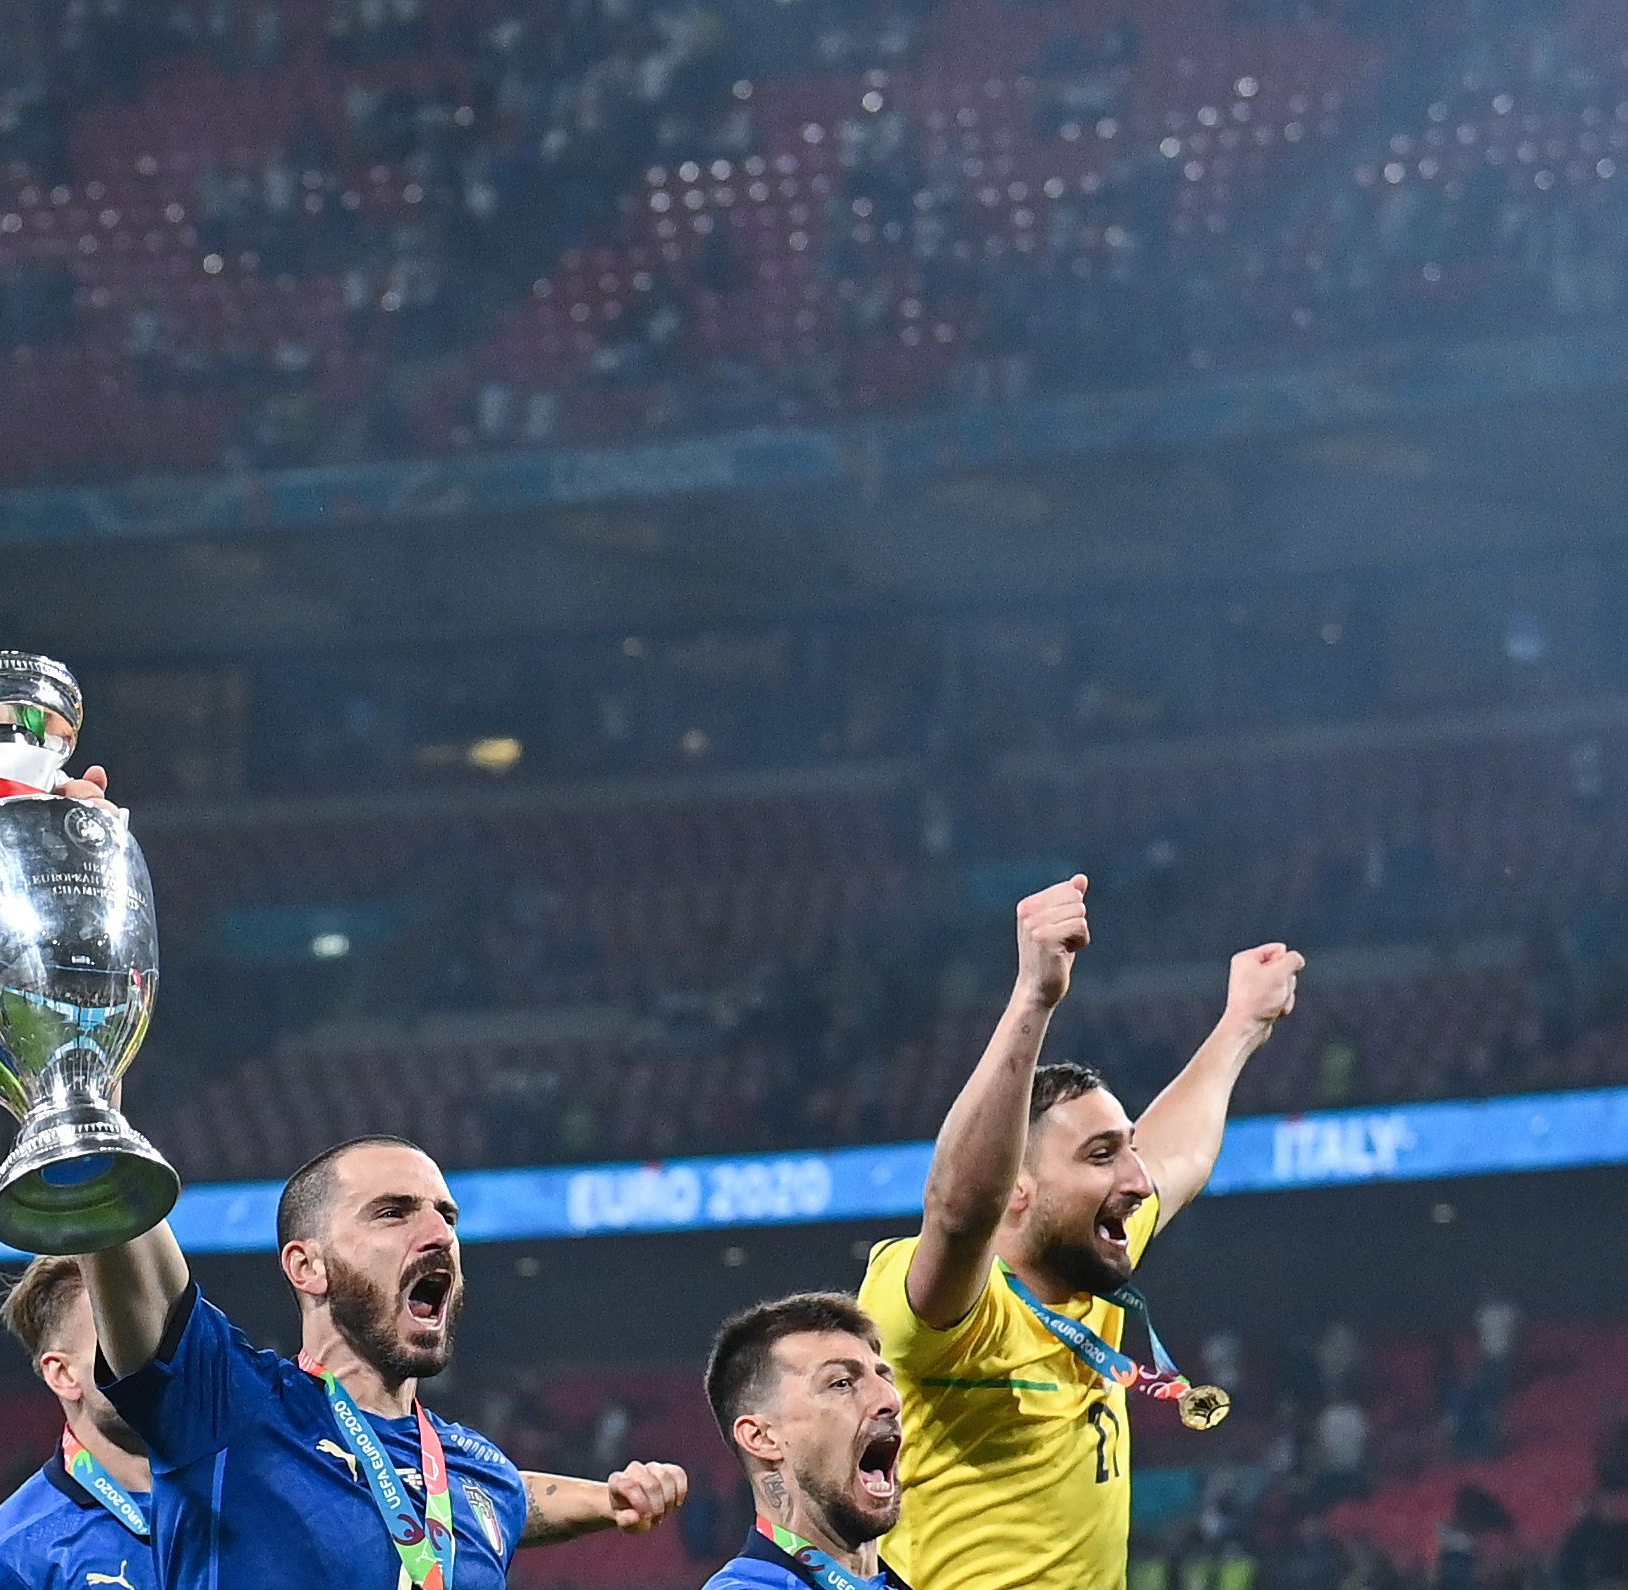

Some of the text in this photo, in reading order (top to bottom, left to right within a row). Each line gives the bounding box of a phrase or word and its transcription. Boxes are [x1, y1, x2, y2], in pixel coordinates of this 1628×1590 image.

[1274, 1114, 1411, 1179] ITALY
[568, 1159, 832, 1232] EURO 2020
[1050, 1318, 1084, 1345] EURO
[1080, 1341, 1107, 1364] 2020
[334, 1400, 402, 1510] UEFA EURO 2020
[1087, 1401, 1120, 1484] 21
[94, 1477, 125, 1506] 2020
